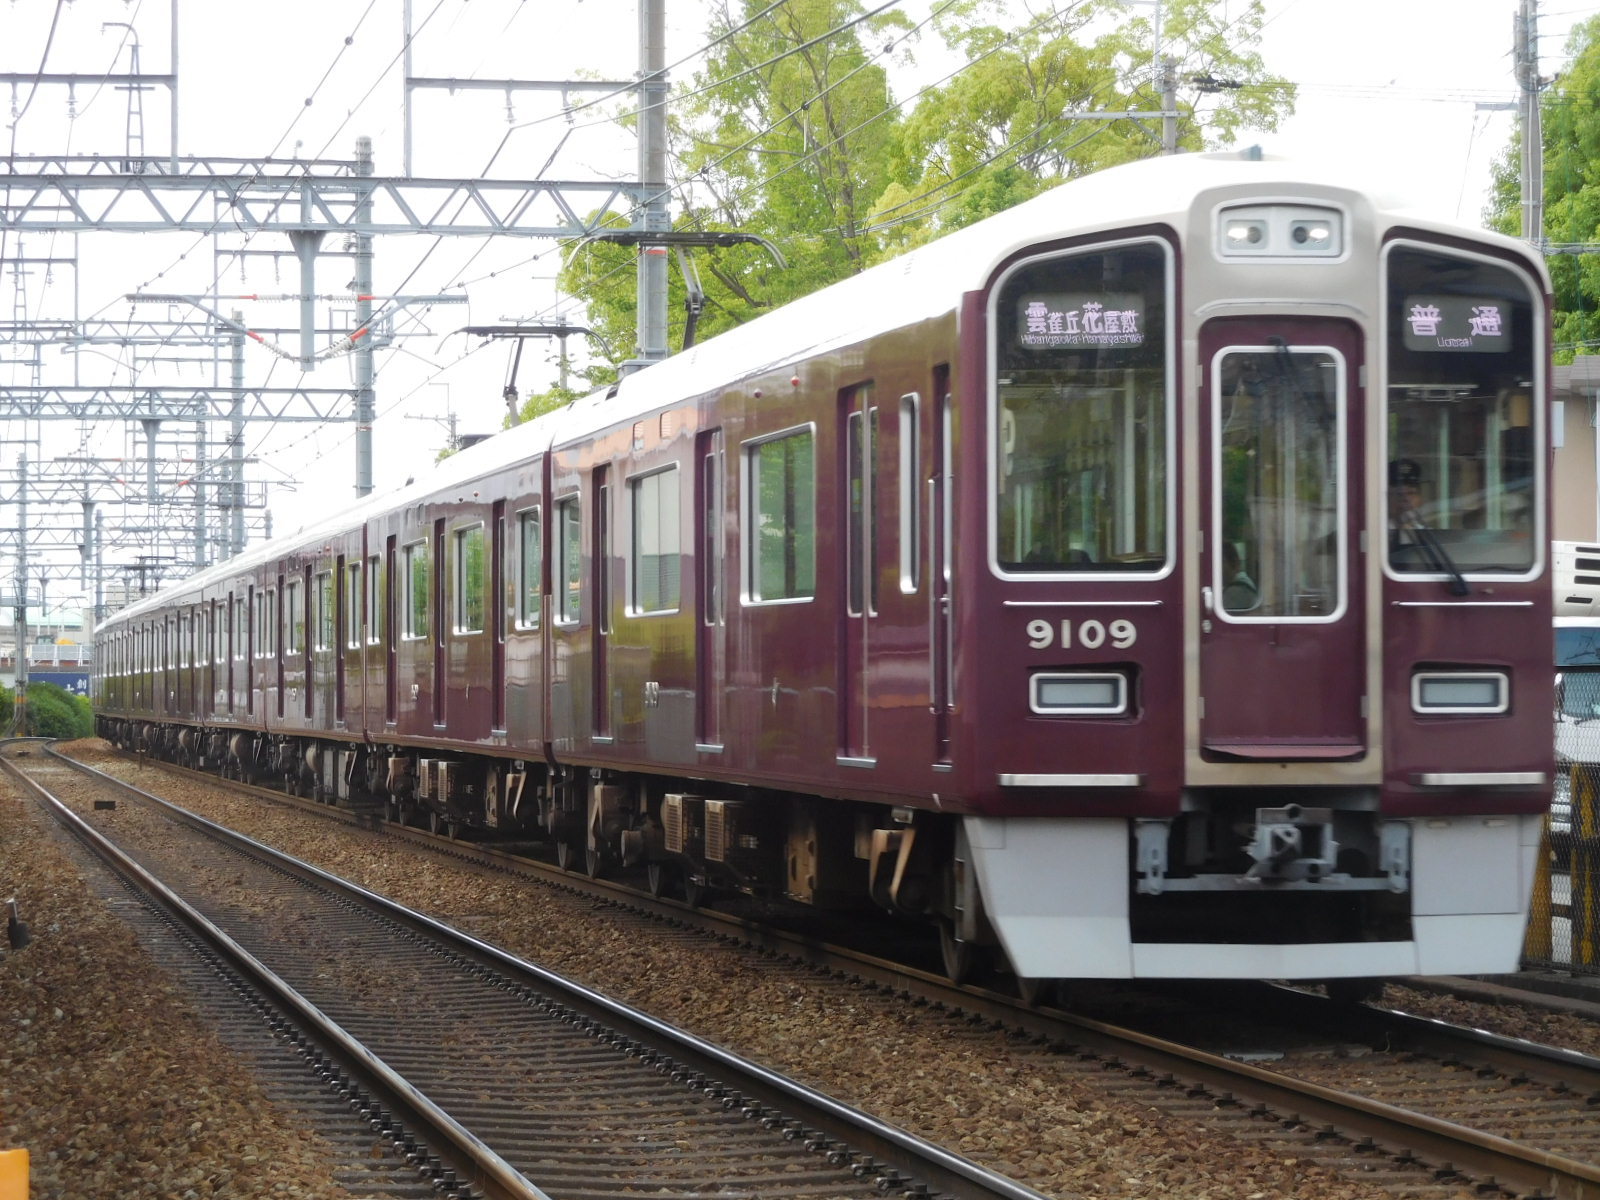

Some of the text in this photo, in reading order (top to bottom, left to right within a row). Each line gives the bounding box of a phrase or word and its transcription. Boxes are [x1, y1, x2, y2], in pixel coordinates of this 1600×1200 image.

[1025, 302, 1140, 334] 雲雀丘花屋敷
[1407, 304, 1502, 336] 普通
[1026, 619, 1137, 649] 9109
